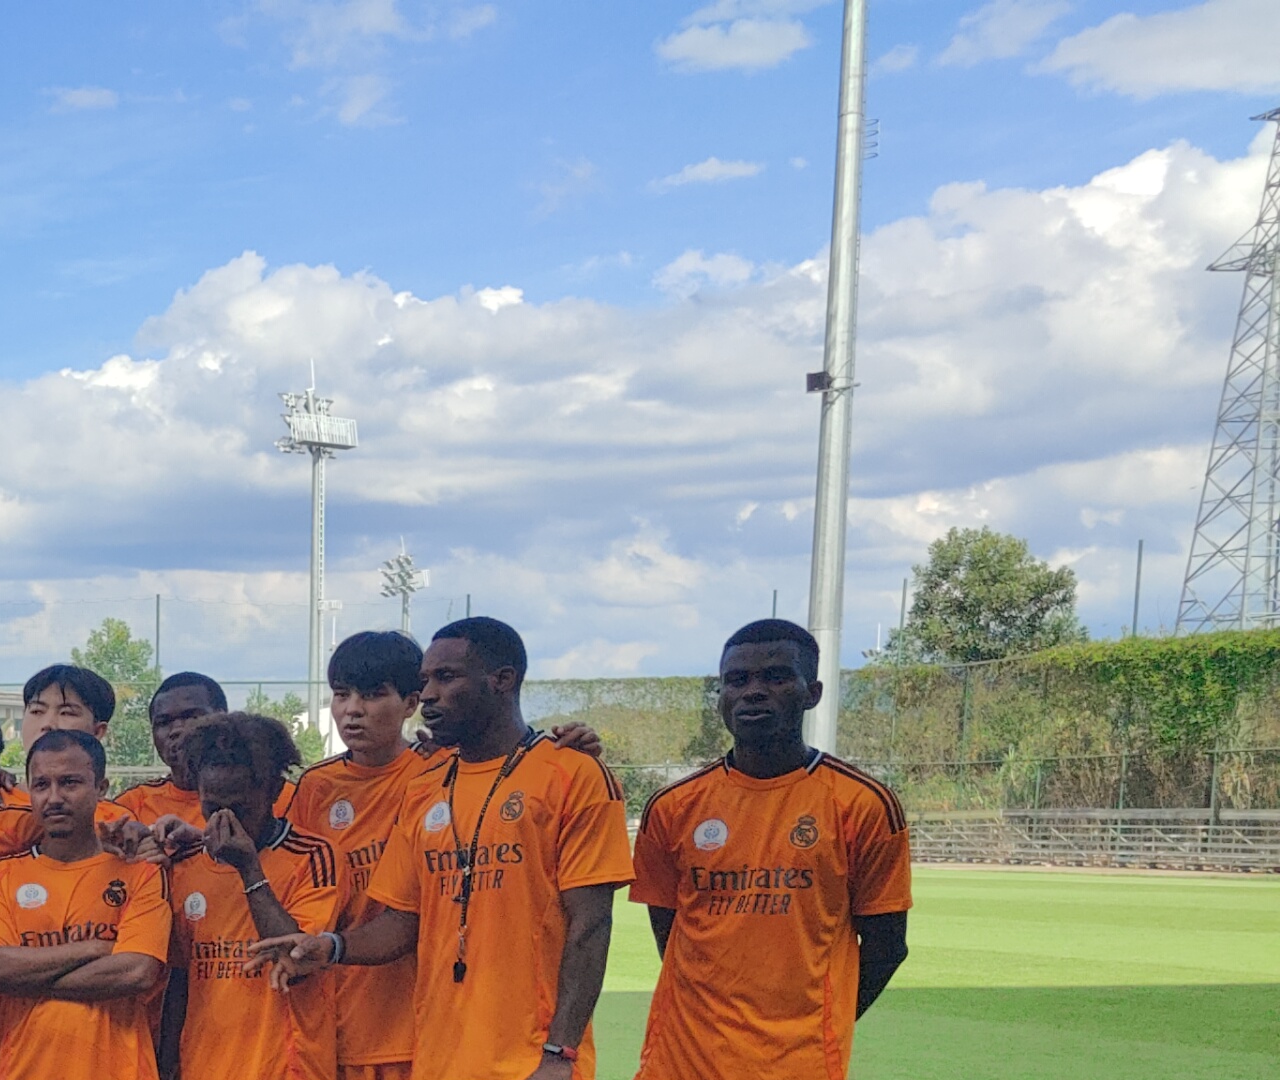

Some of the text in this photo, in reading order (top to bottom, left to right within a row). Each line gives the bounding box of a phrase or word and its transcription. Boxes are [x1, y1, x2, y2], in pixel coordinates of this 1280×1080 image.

[691, 864, 814, 891] Emirates
[708, 893, 792, 916] FLY BETTER
